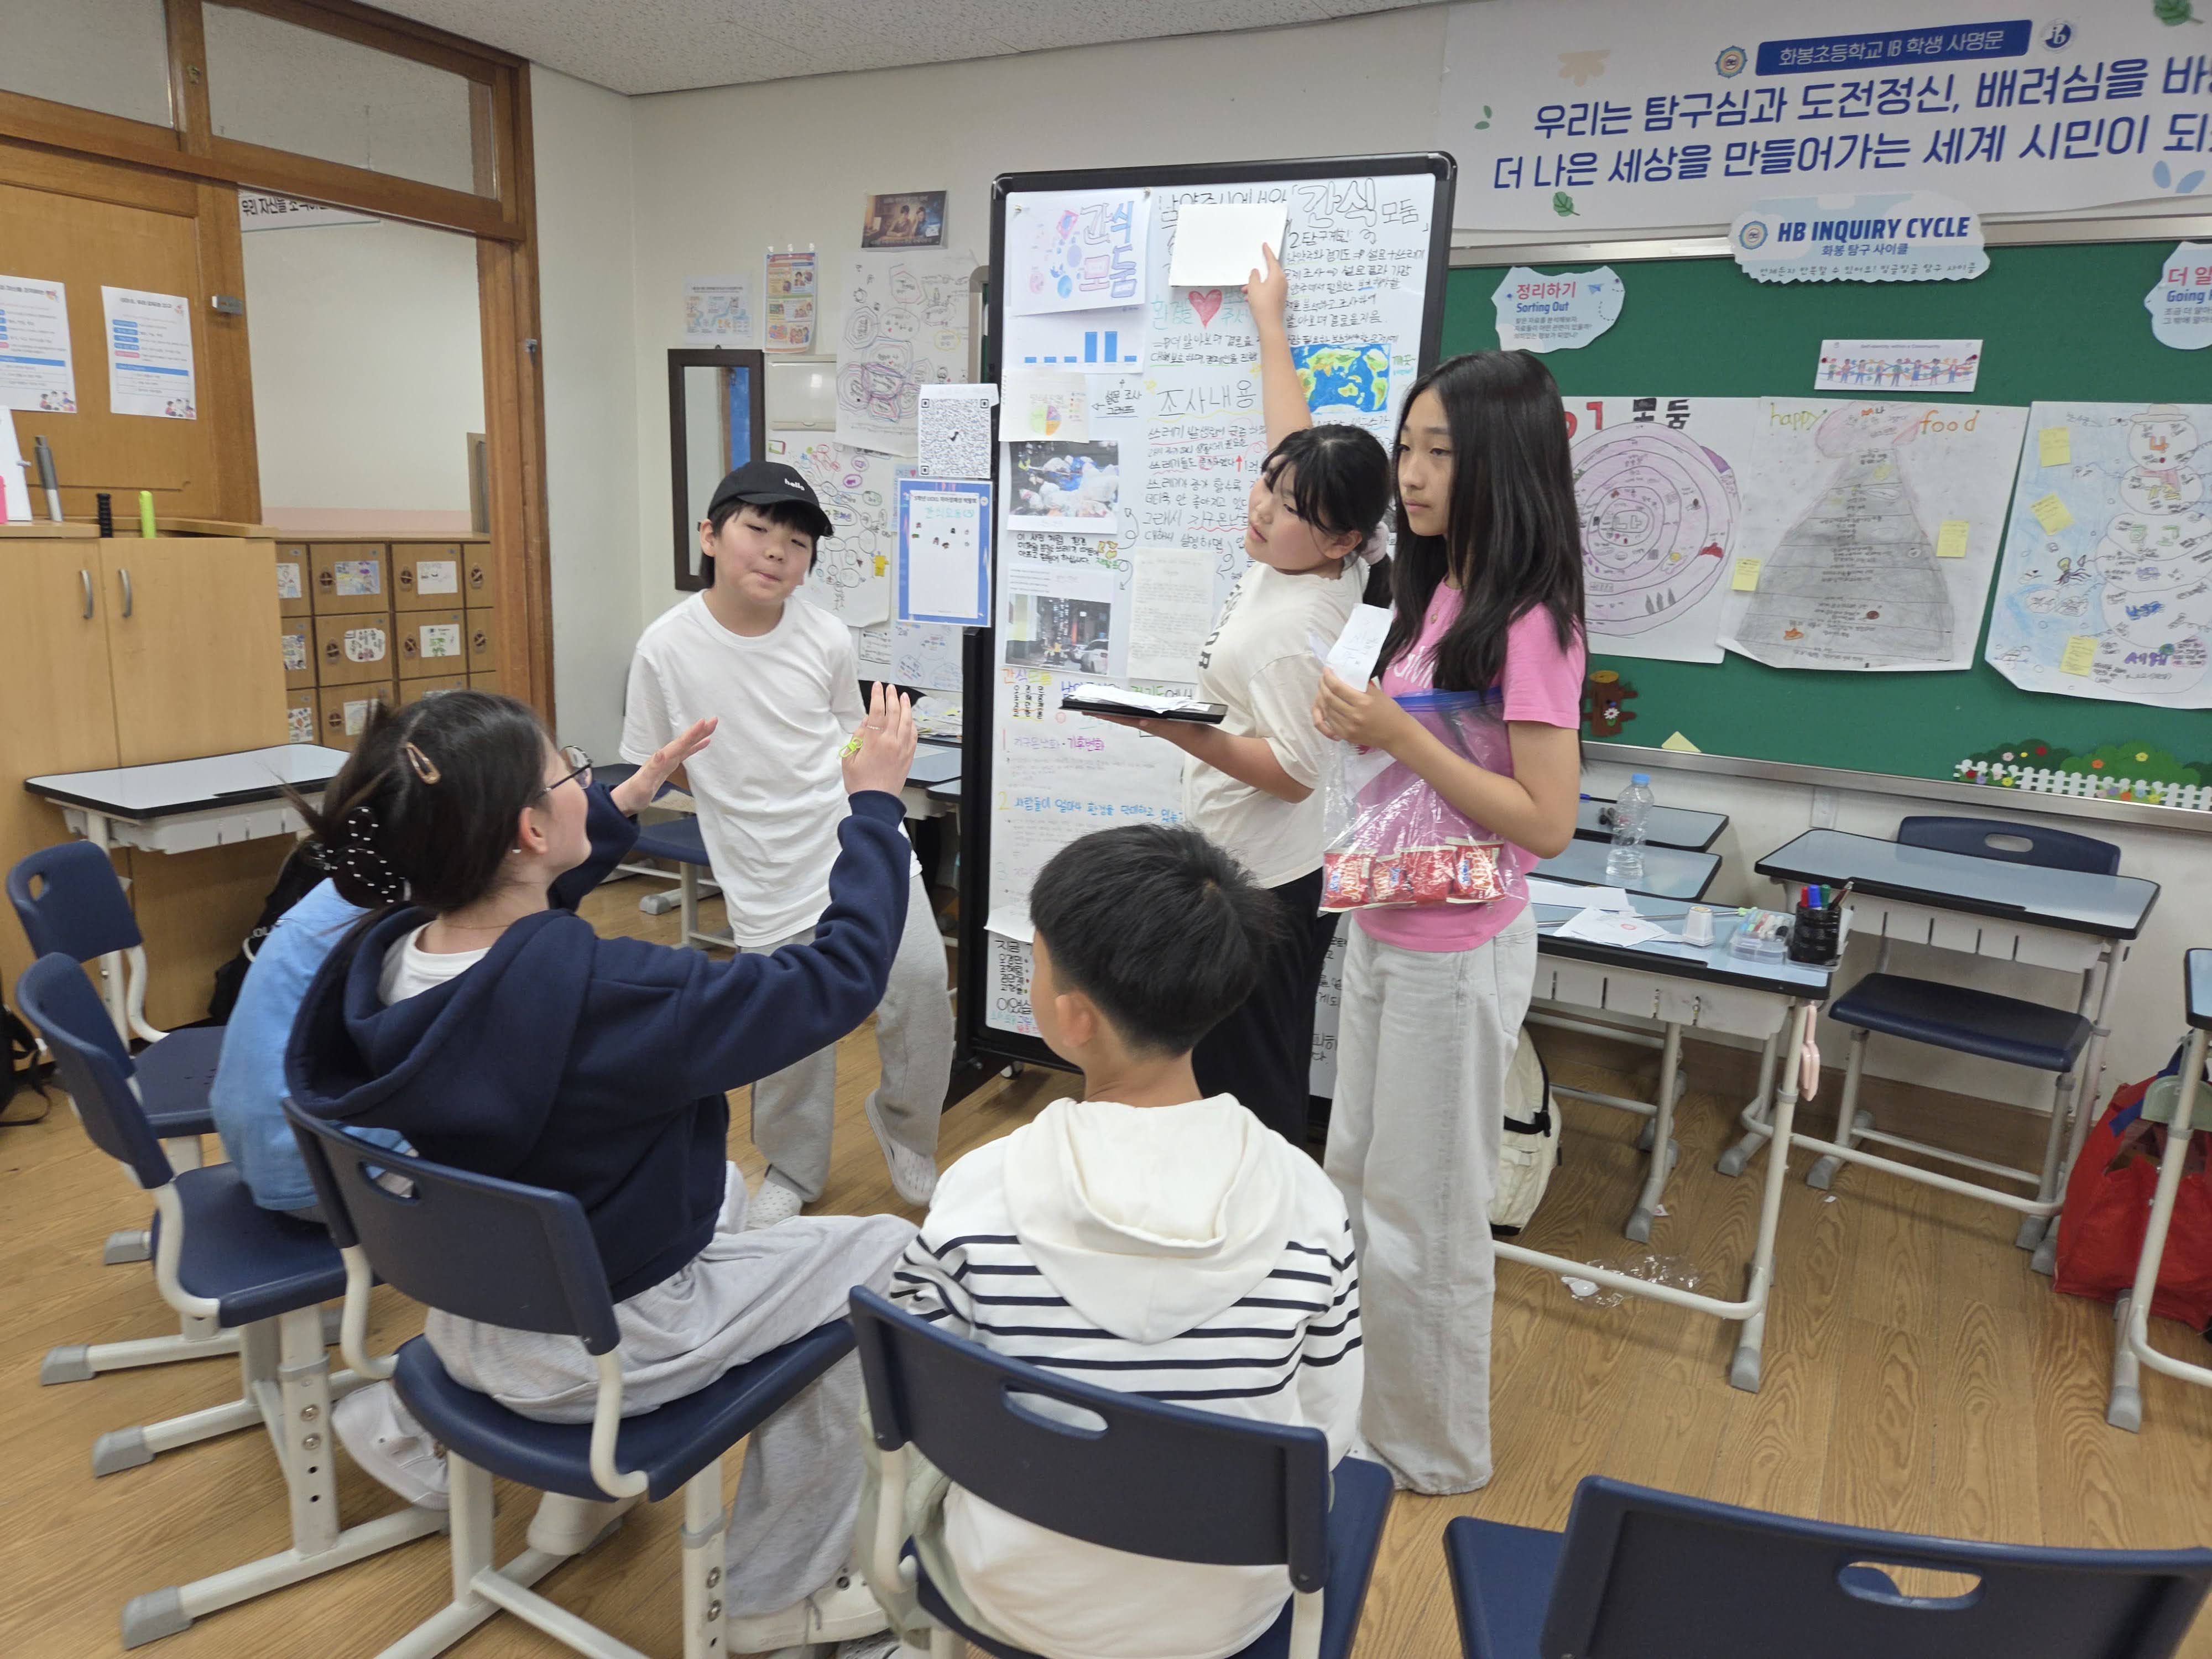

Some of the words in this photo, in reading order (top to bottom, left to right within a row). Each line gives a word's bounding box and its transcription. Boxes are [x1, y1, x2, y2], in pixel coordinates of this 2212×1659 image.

[1778, 40, 1884, 67] 화봉초등학교
[1887, 38, 1901, 57] IB
[1906, 35, 1943, 54] 학생
[1945, 30, 2005, 51] 사명문
[1534, 100, 1632, 139] 우리는
[1644, 86, 1788, 132] 탐구심과
[1797, 73, 1960, 120] 도전정신,
[1975, 58, 2148, 108] 배려심을
[2162, 55, 2212, 95] 바
[1494, 155, 1524, 189] 더
[1533, 152, 1598, 187] 나은
[1608, 144, 1712, 184] 세상을
[1724, 131, 1911, 177] 만들어가는
[1922, 124, 2007, 165] 세계
[2018, 114, 2150, 160] 시민이
[2163, 113, 2212, 153] 되
[1079, 200, 1134, 246] 간식
[1777, 222, 1807, 242] HB
[1811, 219, 1902, 243] INQUIRY
[1906, 217, 1971, 239] CYCLE
[1820, 245, 1846, 257] 화봉
[1848, 244, 1871, 256] 탐구
[1872, 243, 1909, 255] 사이클
[1078, 244, 1138, 298] 모둠
[2167, 266, 2189, 286] 더
[1516, 281, 1577, 300] 정리하기
[2166, 289, 2206, 304] Going
[1516, 302, 1551, 315] Sorting
[1552, 301, 1569, 311] Out
[1633, 398, 1691, 430] 모둠
[1770, 402, 1828, 432] happy
[1919, 409, 1980, 435] food
[784, 478, 805, 491] hello
